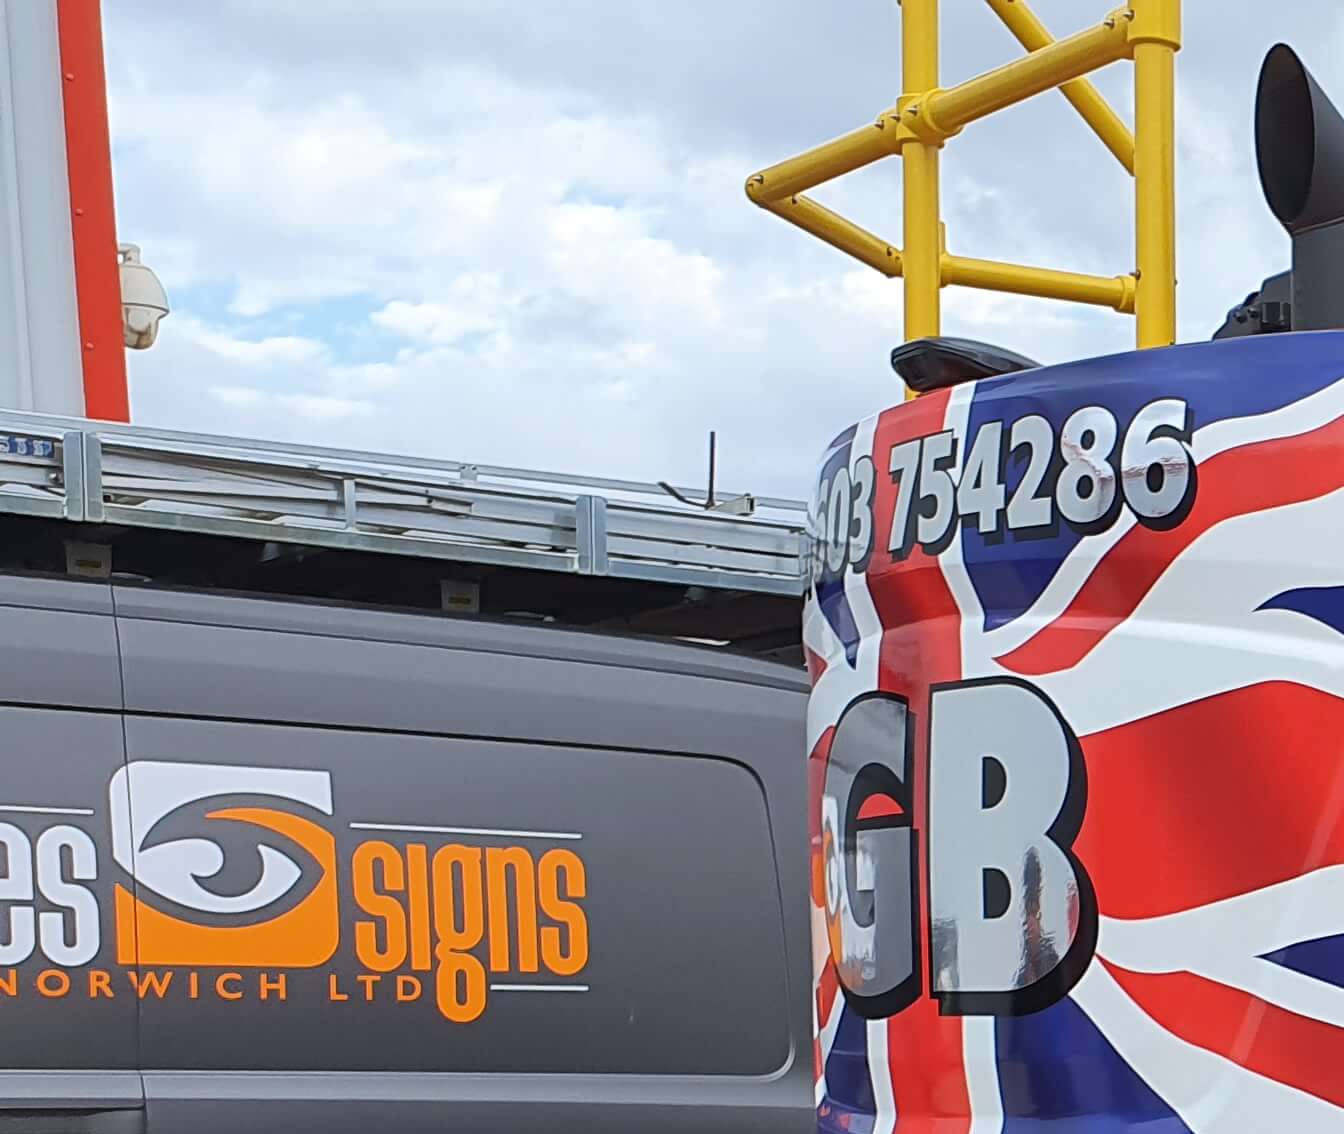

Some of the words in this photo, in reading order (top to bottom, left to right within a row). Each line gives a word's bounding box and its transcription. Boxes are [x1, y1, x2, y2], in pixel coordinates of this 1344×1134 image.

[888, 398, 1194, 556] 754286
[822, 679, 1093, 1008] GB
[0, 969, 287, 1000] NORWICH
[328, 975, 422, 1002] LTD
[351, 841, 588, 1022] signs
